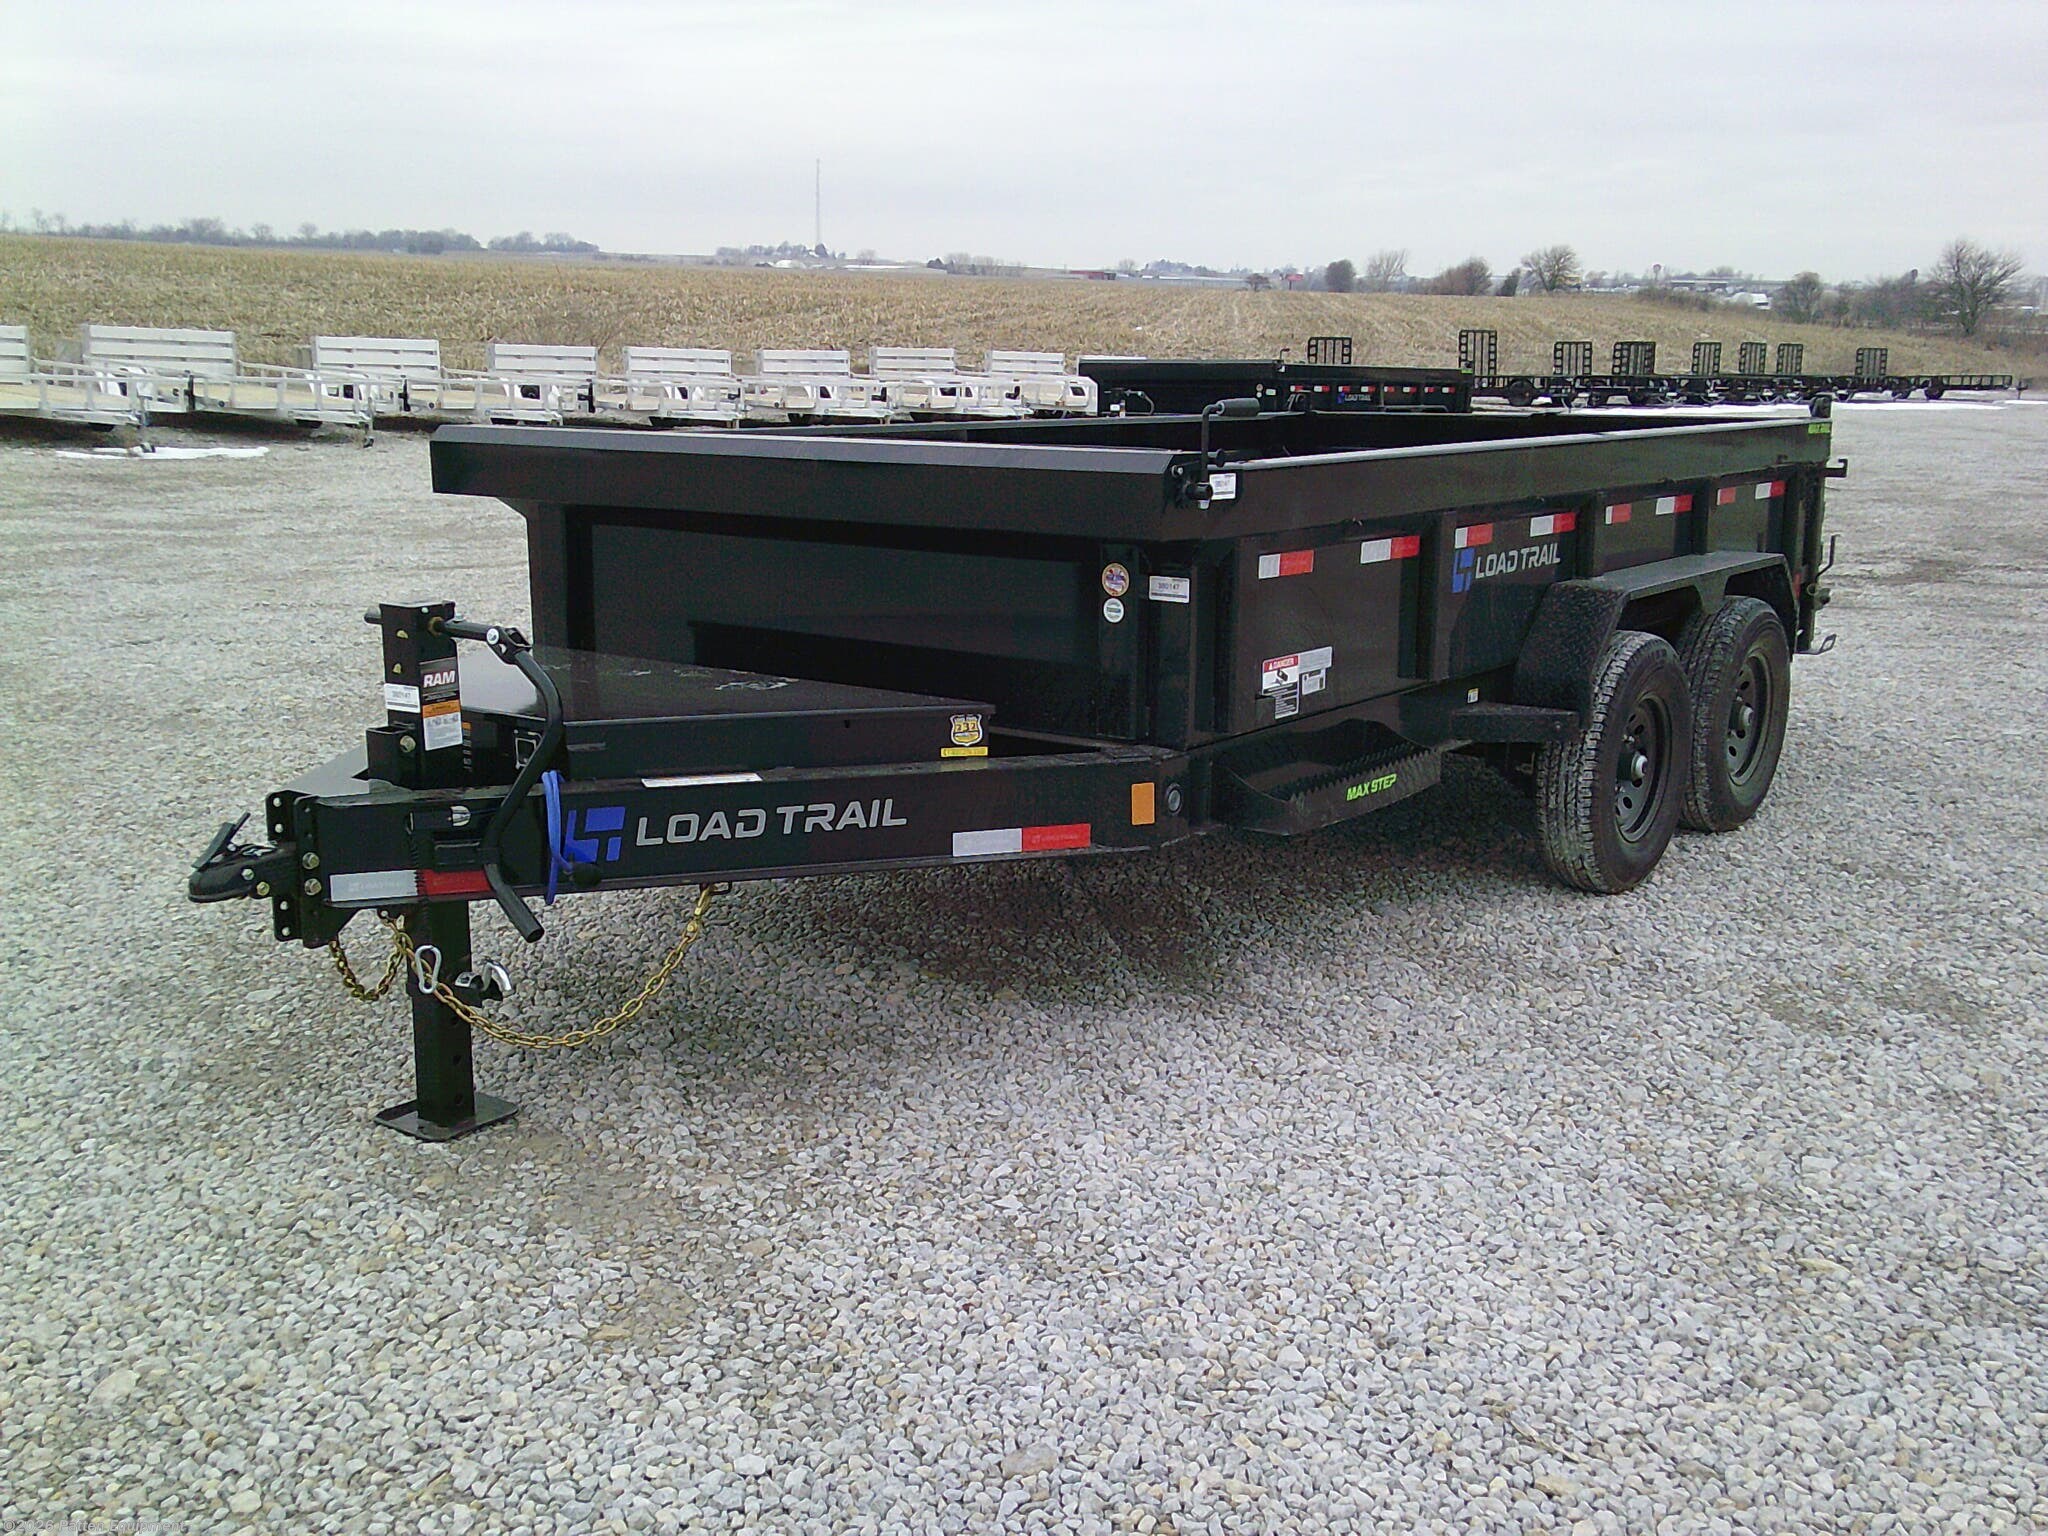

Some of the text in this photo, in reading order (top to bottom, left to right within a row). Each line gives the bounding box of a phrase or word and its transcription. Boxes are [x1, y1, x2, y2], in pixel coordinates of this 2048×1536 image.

[1475, 542, 1561, 579] LOAD TRAIL
[423, 671, 456, 688] RAM
[1346, 773, 1397, 801] MAX STEP
[636, 798, 908, 846] LOAD TRAIL
